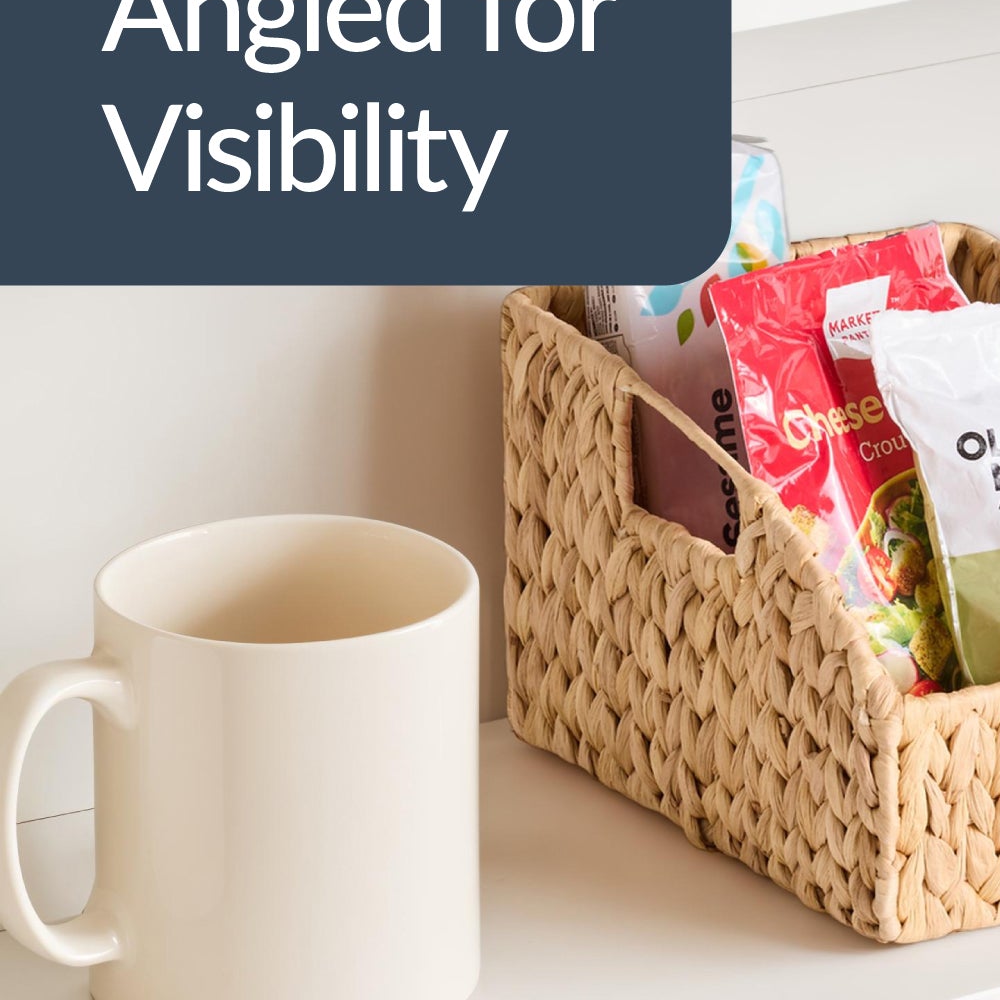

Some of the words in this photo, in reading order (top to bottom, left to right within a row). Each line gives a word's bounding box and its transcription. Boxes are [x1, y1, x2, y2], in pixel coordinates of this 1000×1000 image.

[782, 394, 885, 450] Cheese
[859, 434, 908, 462] Crou
[711, 388, 740, 548] Sesme
